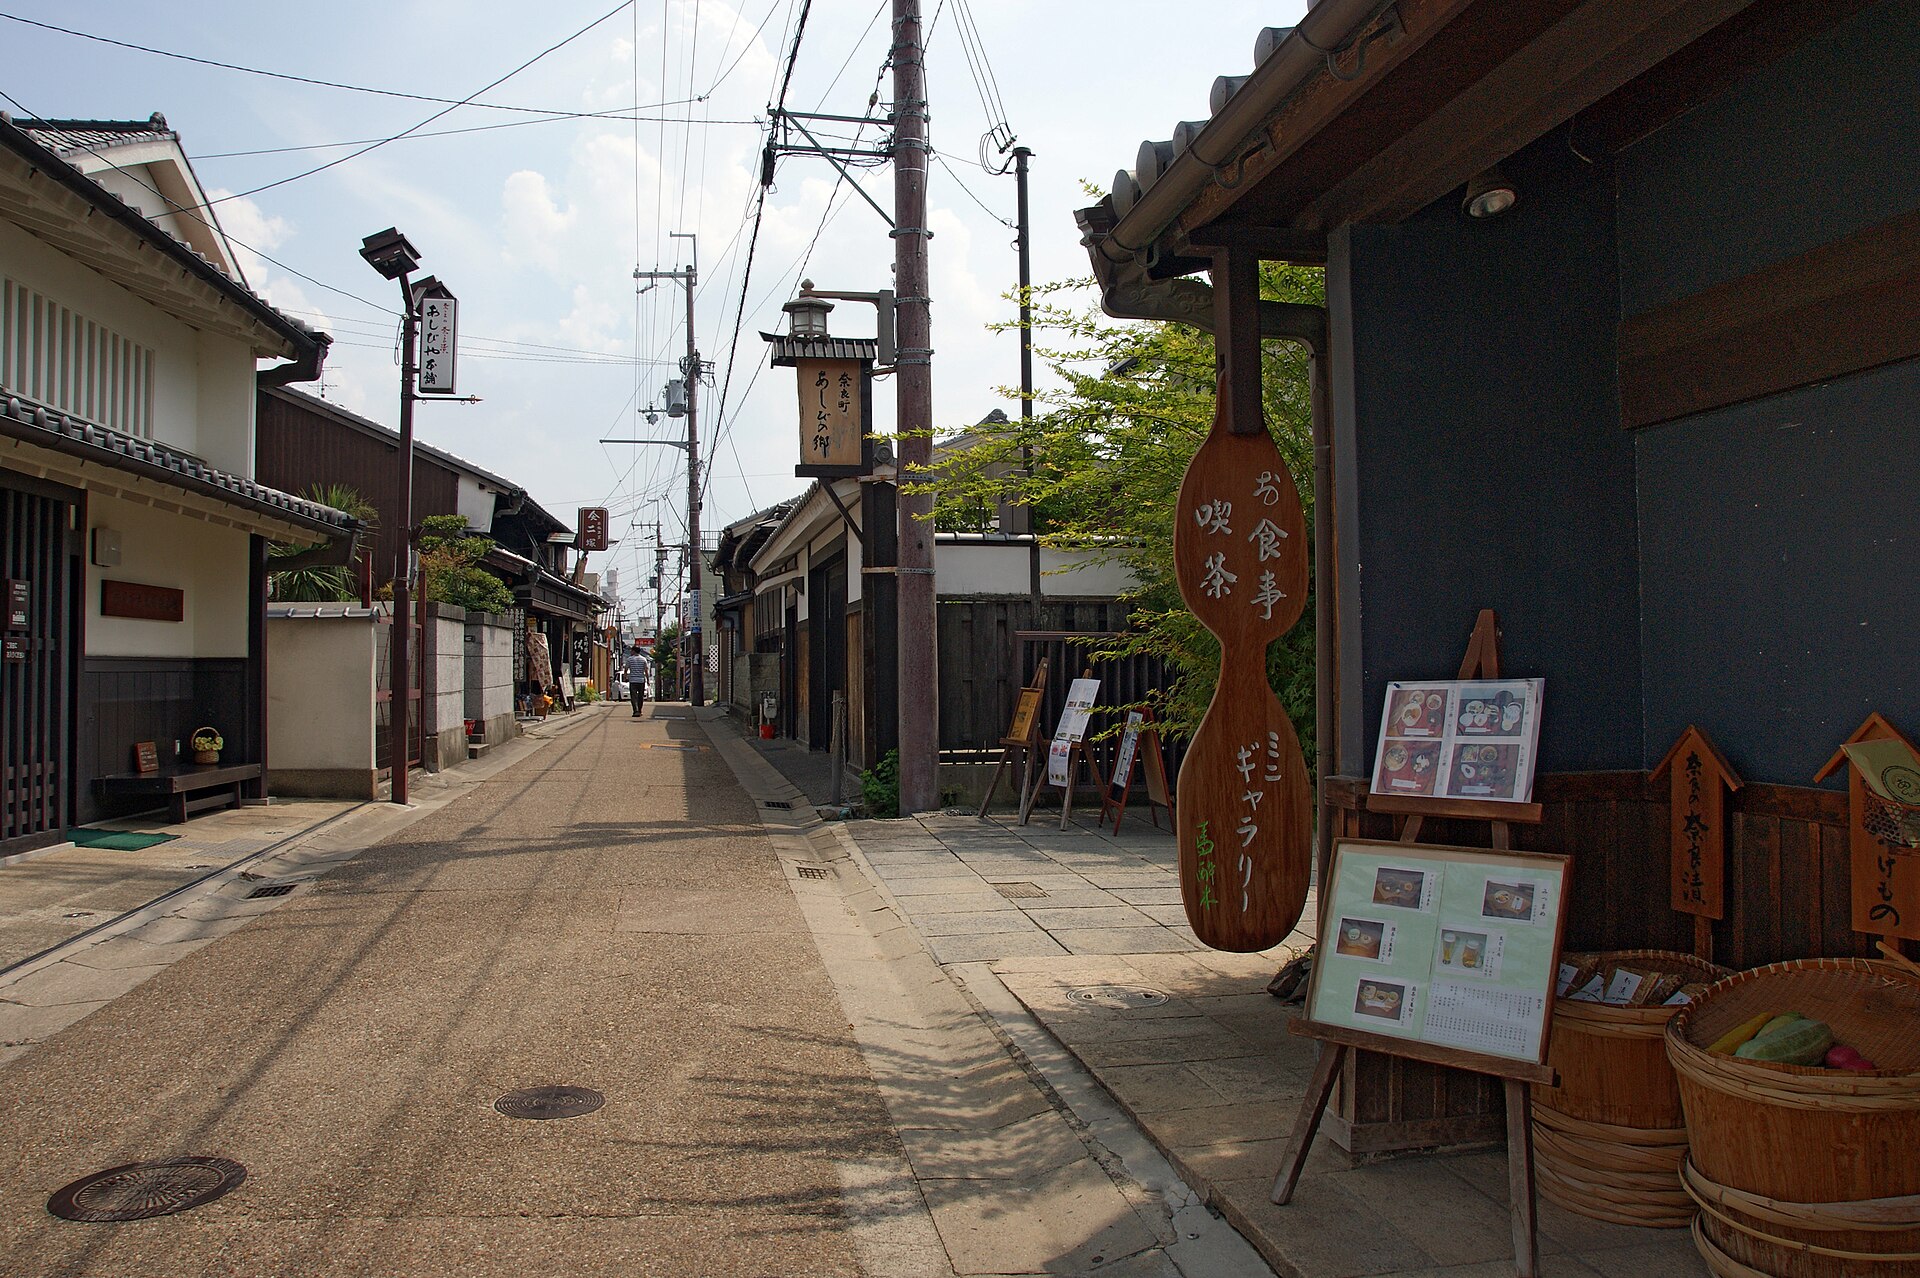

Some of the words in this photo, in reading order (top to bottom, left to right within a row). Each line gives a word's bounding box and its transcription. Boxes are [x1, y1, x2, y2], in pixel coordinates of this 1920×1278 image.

[812, 370, 831, 459] あしびの郷
[838, 371, 852, 413] 奈良町
[1194, 498, 1238, 599] 喫茶
[1248, 470, 1289, 620] お食事
[1264, 731, 1282, 782] ミニ
[1236, 741, 1264, 913] ギャラリー
[1682, 750, 1710, 906] 奈良の奈良漬
[1868, 837, 1900, 928] けもの
